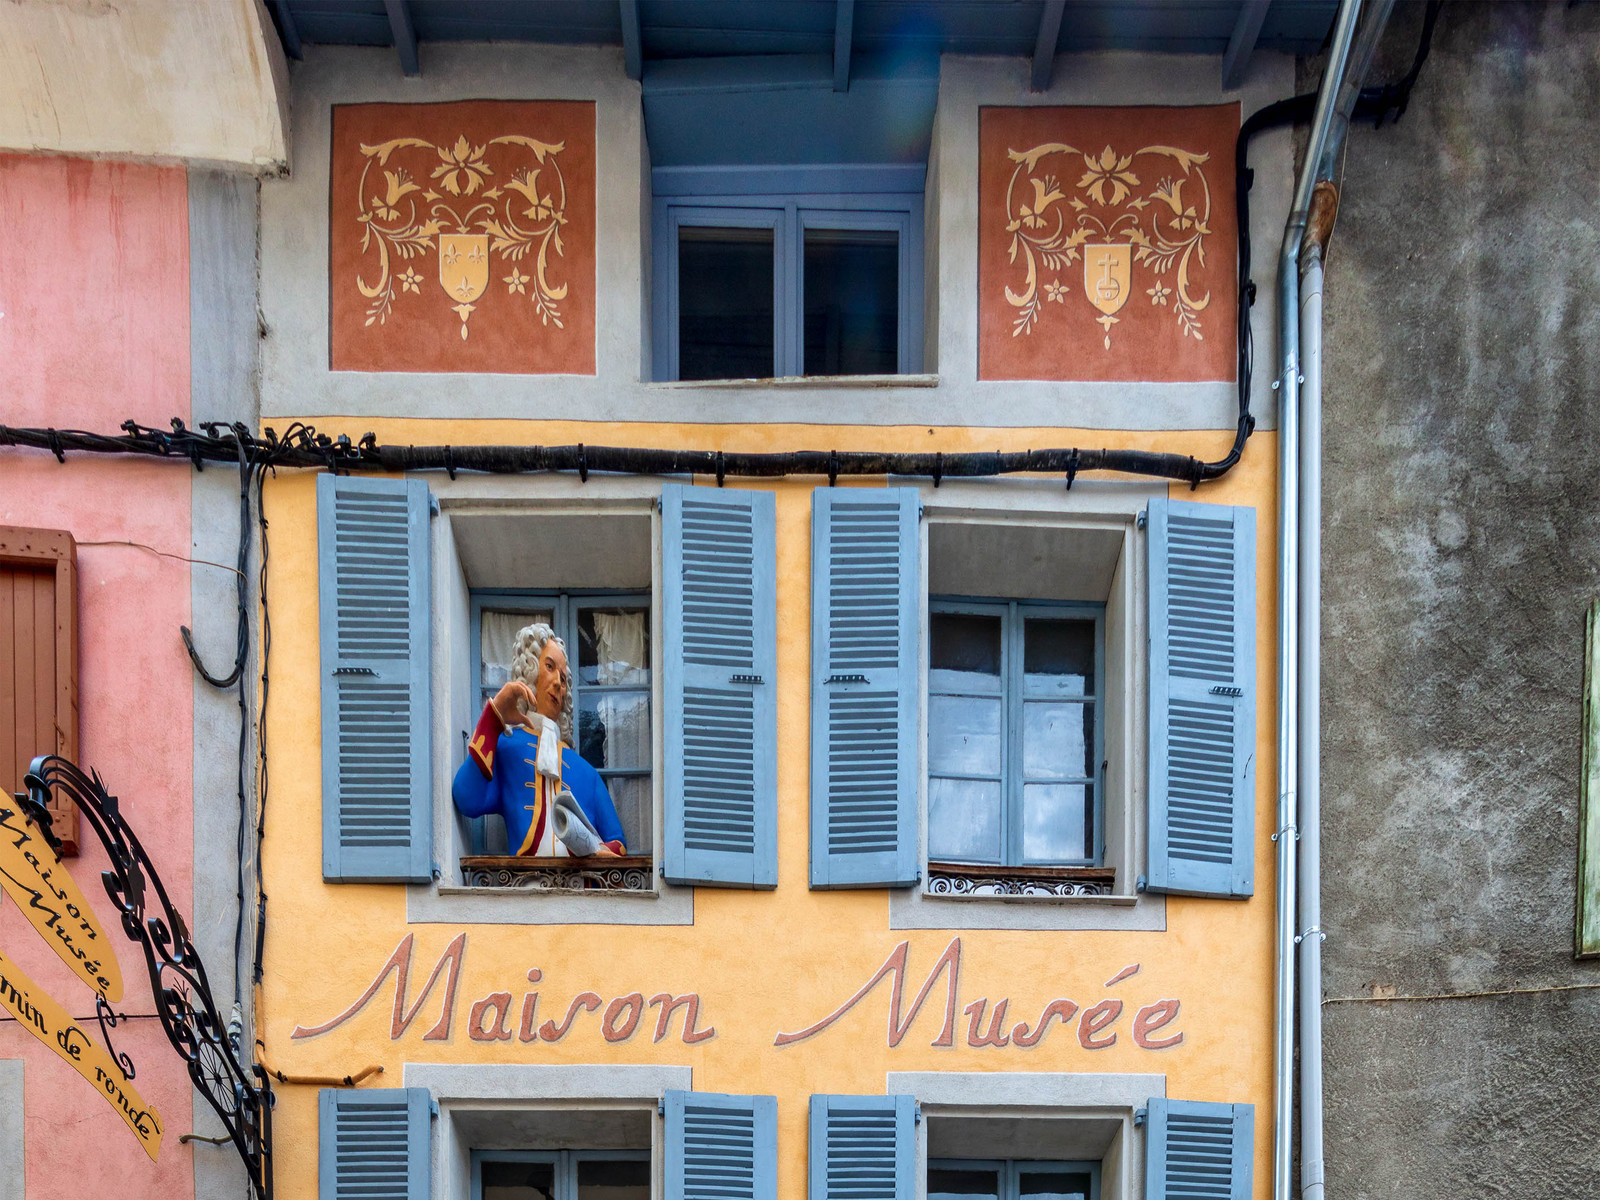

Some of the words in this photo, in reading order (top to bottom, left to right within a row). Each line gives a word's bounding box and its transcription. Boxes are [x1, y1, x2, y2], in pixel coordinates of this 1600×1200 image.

[290, 932, 715, 1045] Maison
[773, 936, 1185, 1050] Musée
[56, 1026, 91, 1061] de
[95, 1066, 160, 1140] ronde
